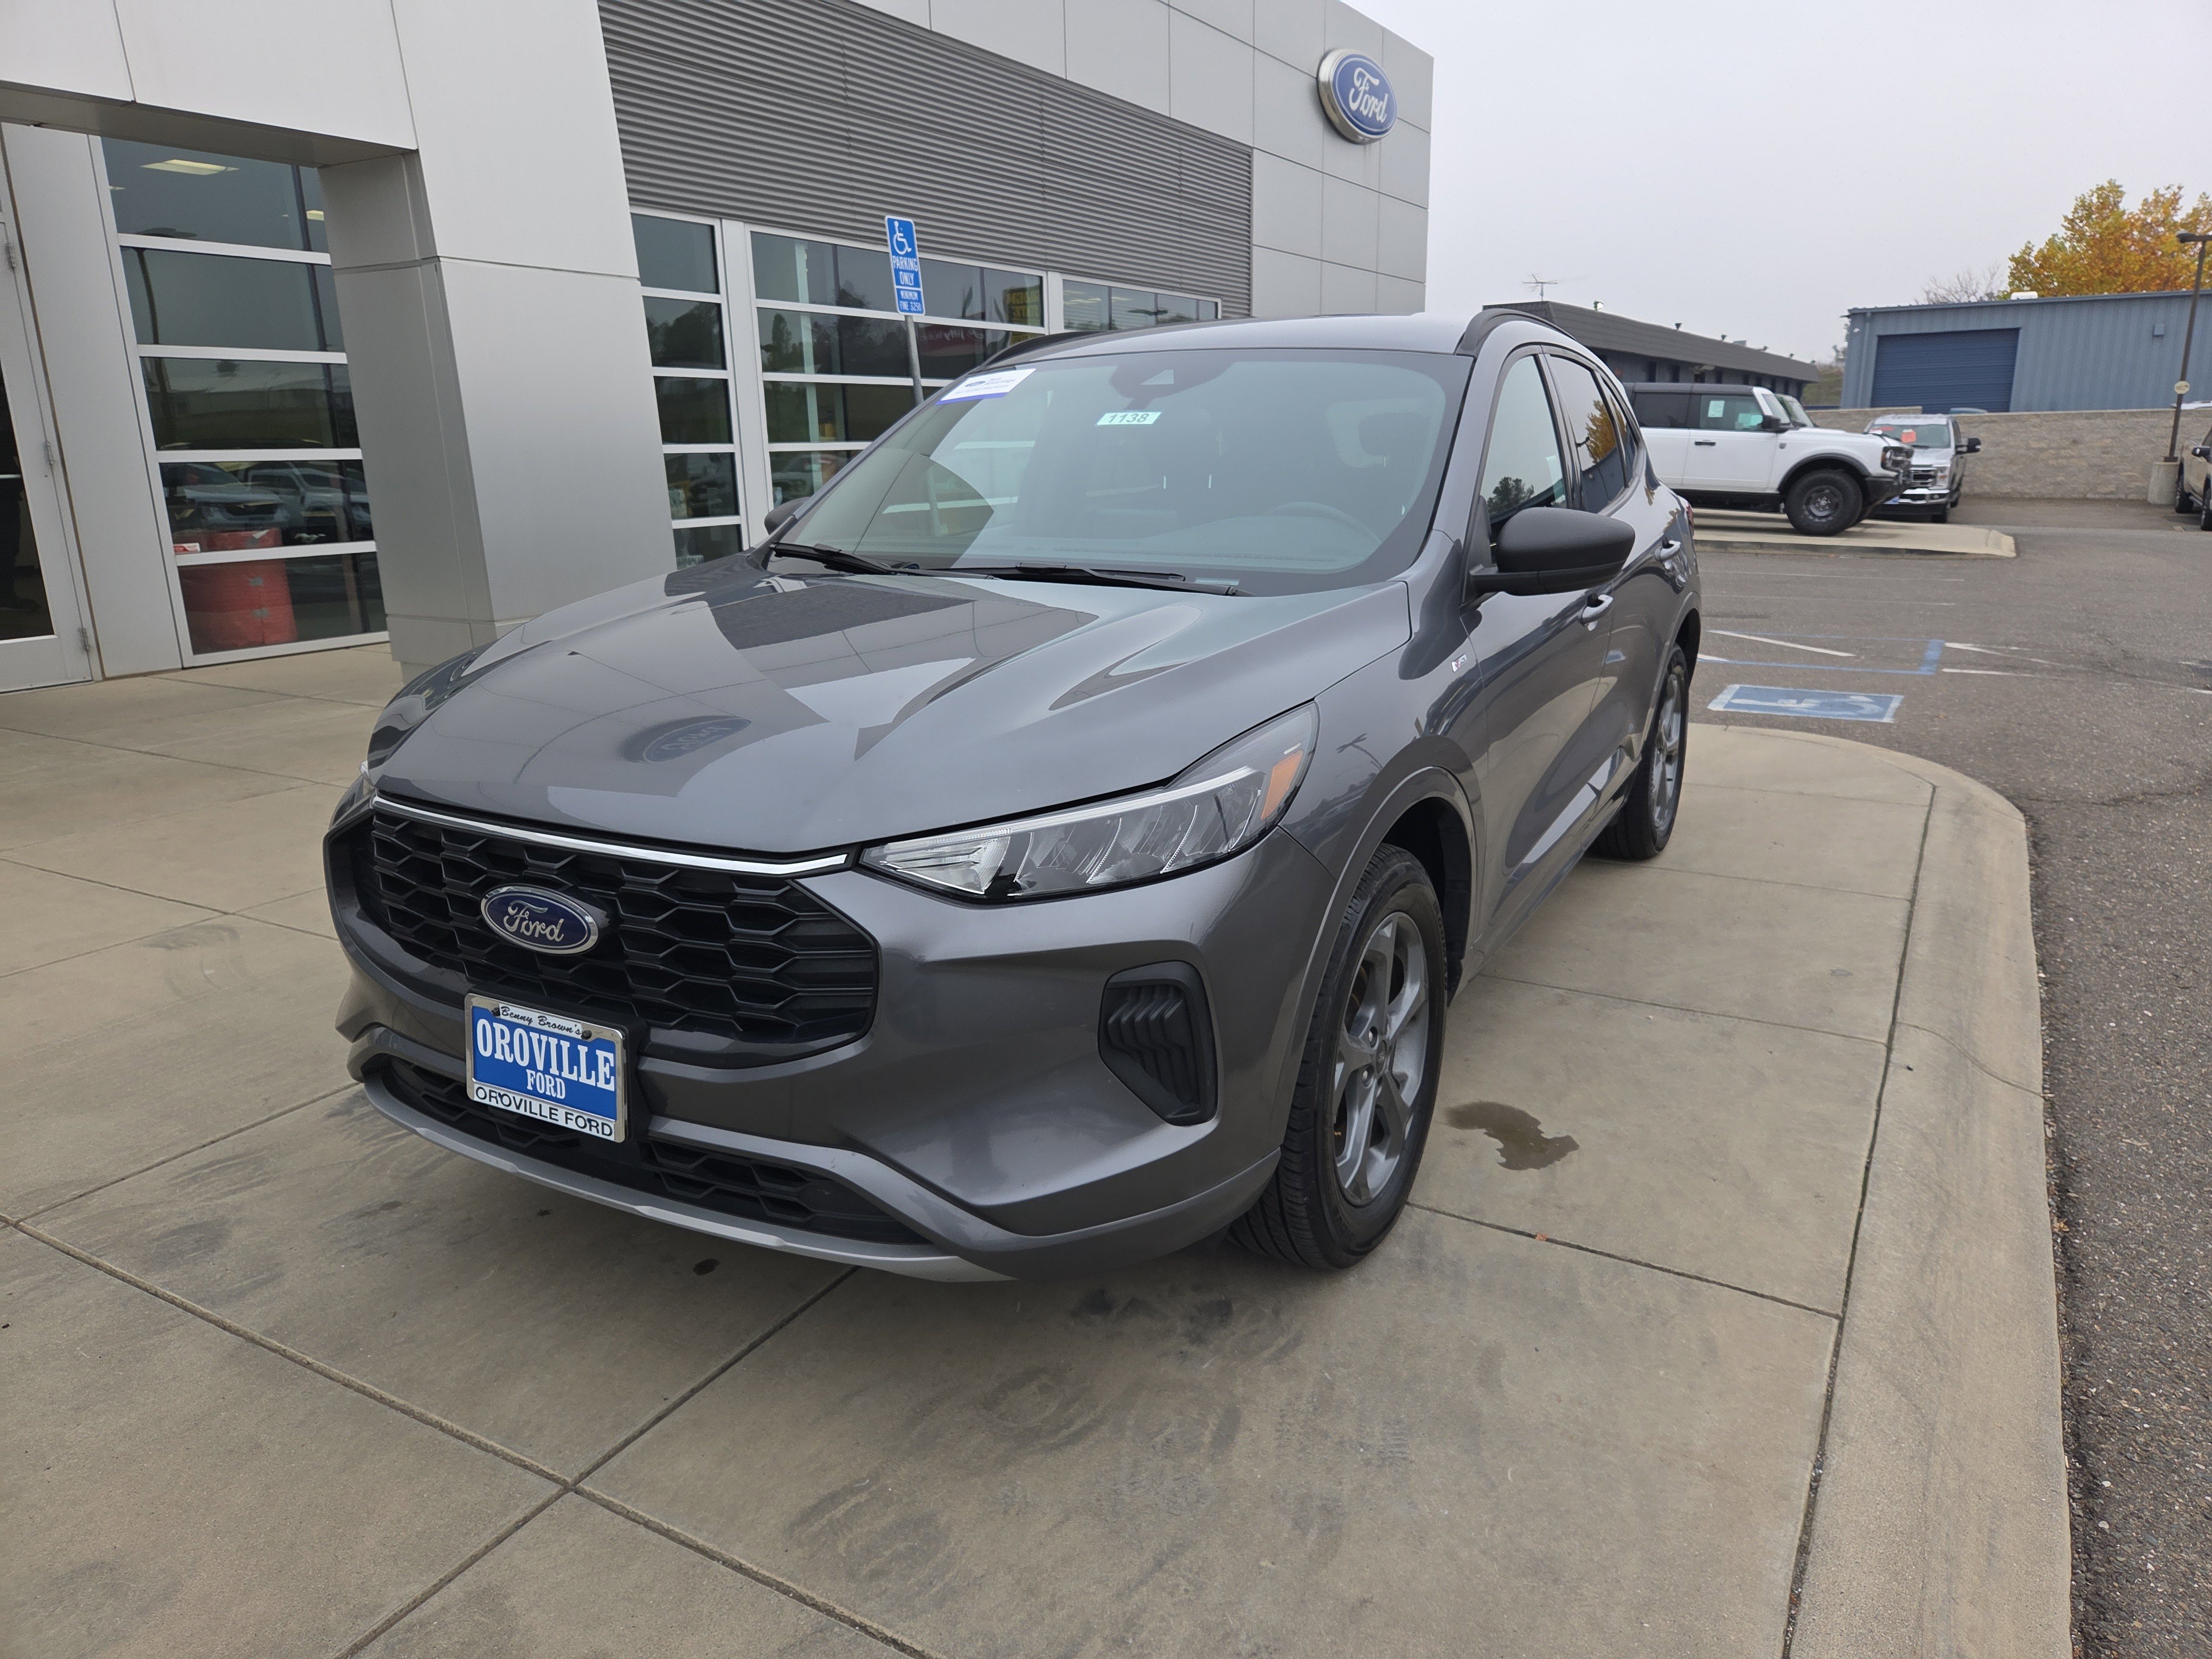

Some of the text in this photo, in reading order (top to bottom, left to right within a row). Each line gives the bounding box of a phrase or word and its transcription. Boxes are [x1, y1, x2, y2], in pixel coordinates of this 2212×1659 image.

[1349, 67, 1389, 123] Ford
[892, 256, 919, 272] PARKING
[899, 272, 915, 286] ONLY
[1109, 413, 1149, 423] 1138
[503, 900, 564, 942] Ford
[501, 1006, 582, 1035] Benny Brown's
[477, 1018, 615, 1092] OROVILLE
[526, 1069, 565, 1099] FORD
[475, 1086, 613, 1137] OROVILLE FORD
